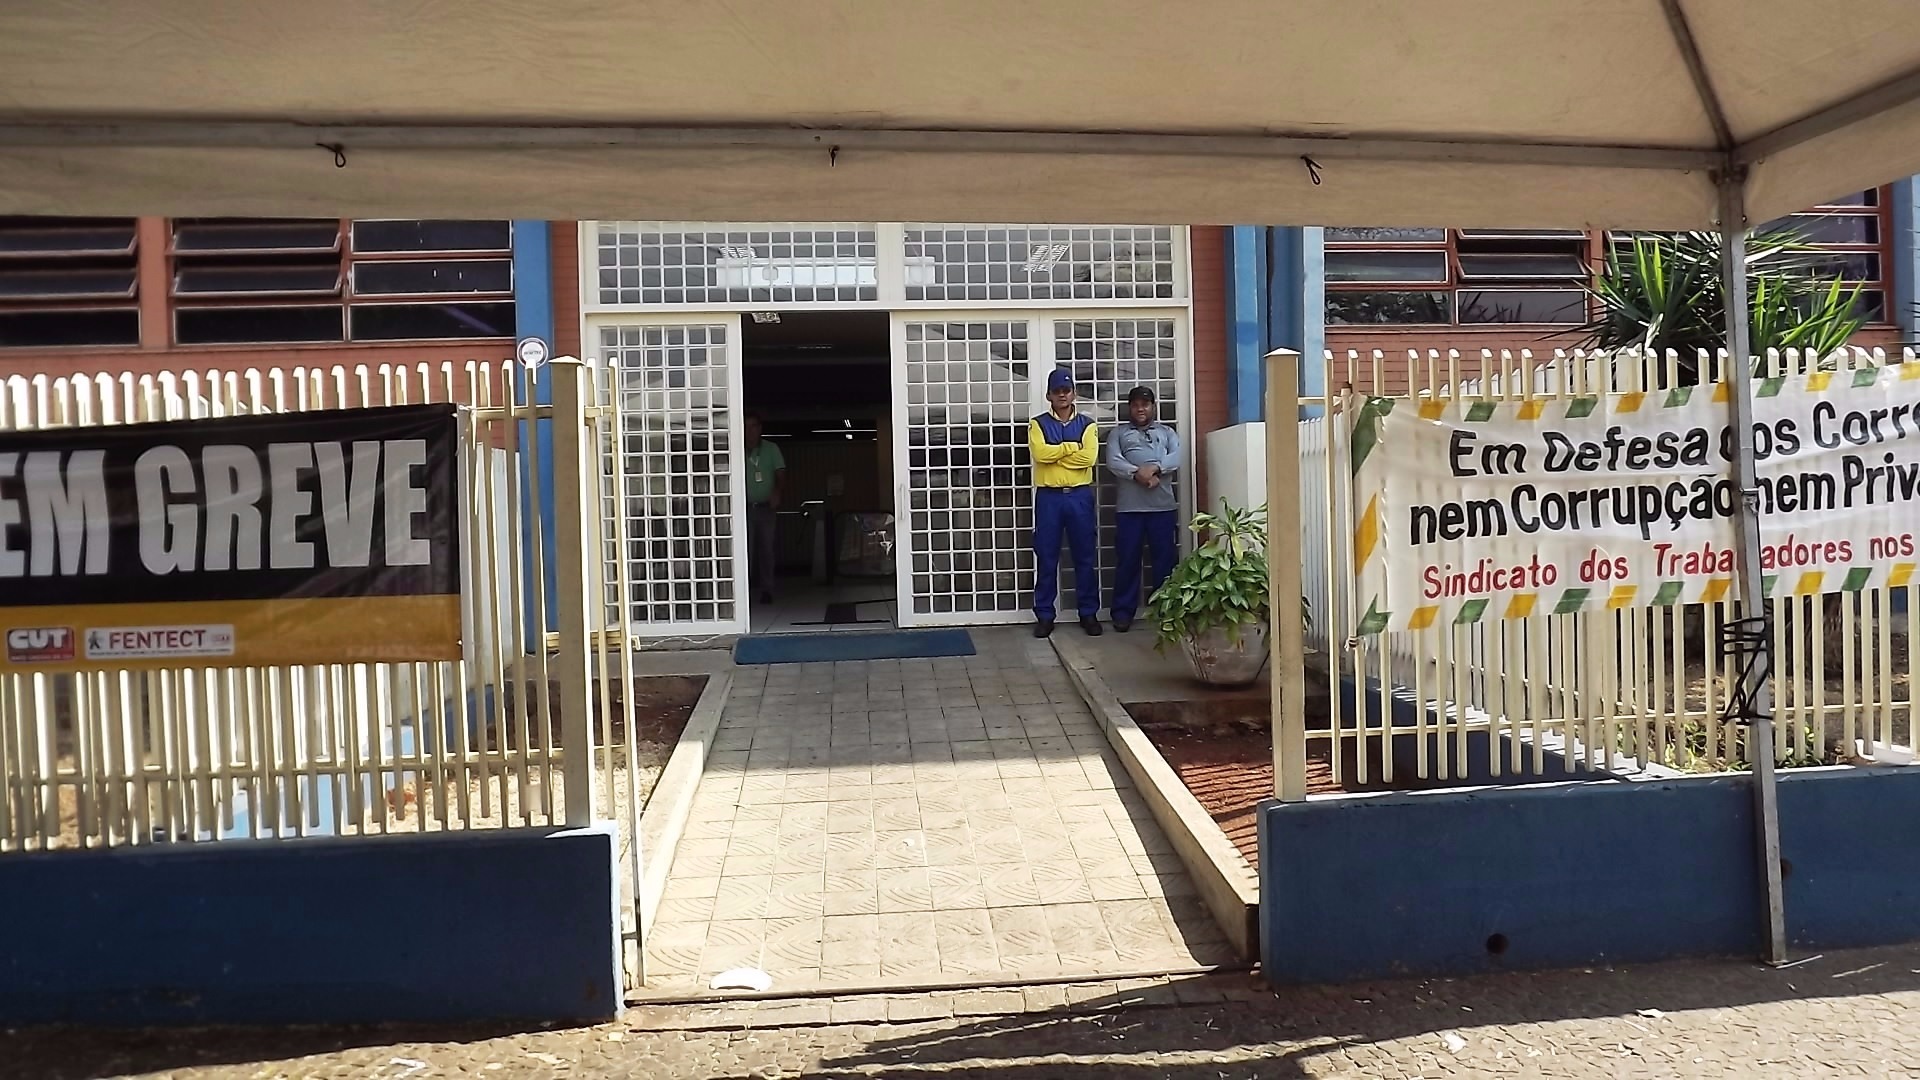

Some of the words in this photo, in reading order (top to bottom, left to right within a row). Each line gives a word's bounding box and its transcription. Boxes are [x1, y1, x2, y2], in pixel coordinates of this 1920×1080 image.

[1450, 430, 1527, 477] Em
[1542, 426, 1710, 472] Defesa
[135, 439, 430, 576] GREVE
[1410, 498, 1508, 545] nem
[1511, 474, 1735, 540] Corrupção
[1754, 473, 1836, 515] nem
[1842, 452, 1920, 508] Priv
[1424, 554, 1557, 599] Sindicato
[1579, 548, 1629, 583] dos
[1653, 534, 1853, 577] Trabaadores
[1870, 533, 1914, 560] nos
[8, 628, 68, 649] CUT
[109, 629, 206, 649] FENTECT
